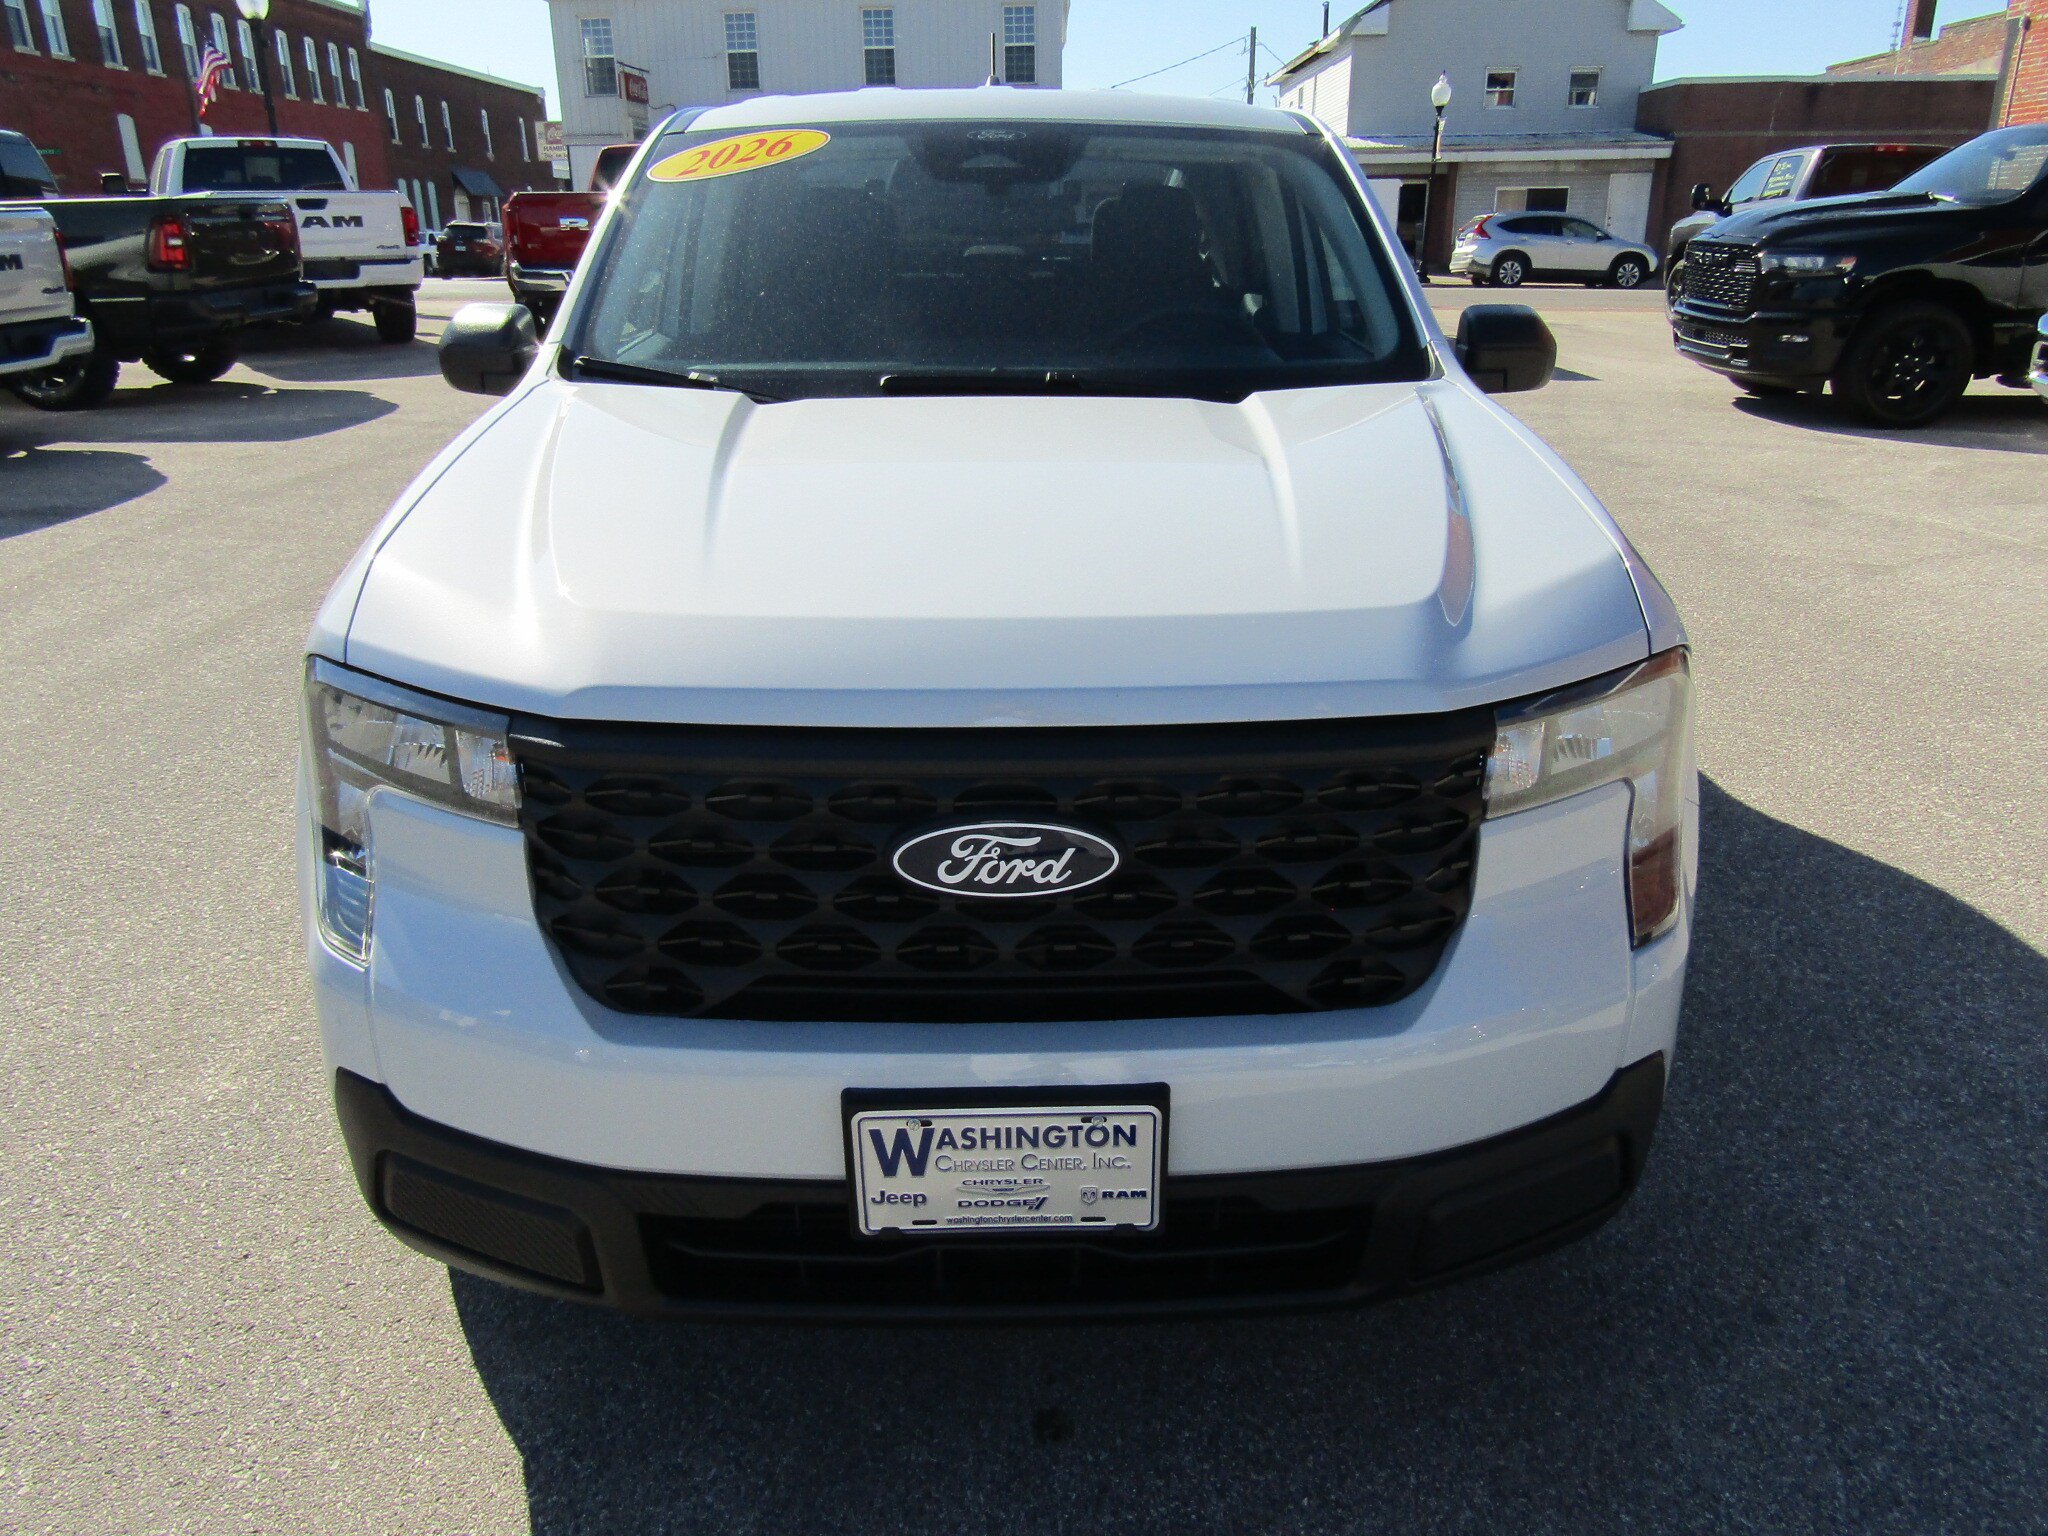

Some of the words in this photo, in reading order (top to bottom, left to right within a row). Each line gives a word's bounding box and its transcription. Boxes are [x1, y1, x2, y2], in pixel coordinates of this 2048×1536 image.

[675, 132, 801, 178] 2026
[937, 834, 1076, 884] Ford
[867, 1125, 1137, 1178] WASHINGTON
[934, 1154, 1014, 1172] CHRYSLER
[962, 1178, 1043, 1186] CHRYSLER
[870, 1190, 928, 1207] Jeep
[1101, 1190, 1147, 1199] RAM
[958, 1199, 1038, 1208] DODGE
[945, 1214, 1073, 1225] washingtonchryslercenter.com
